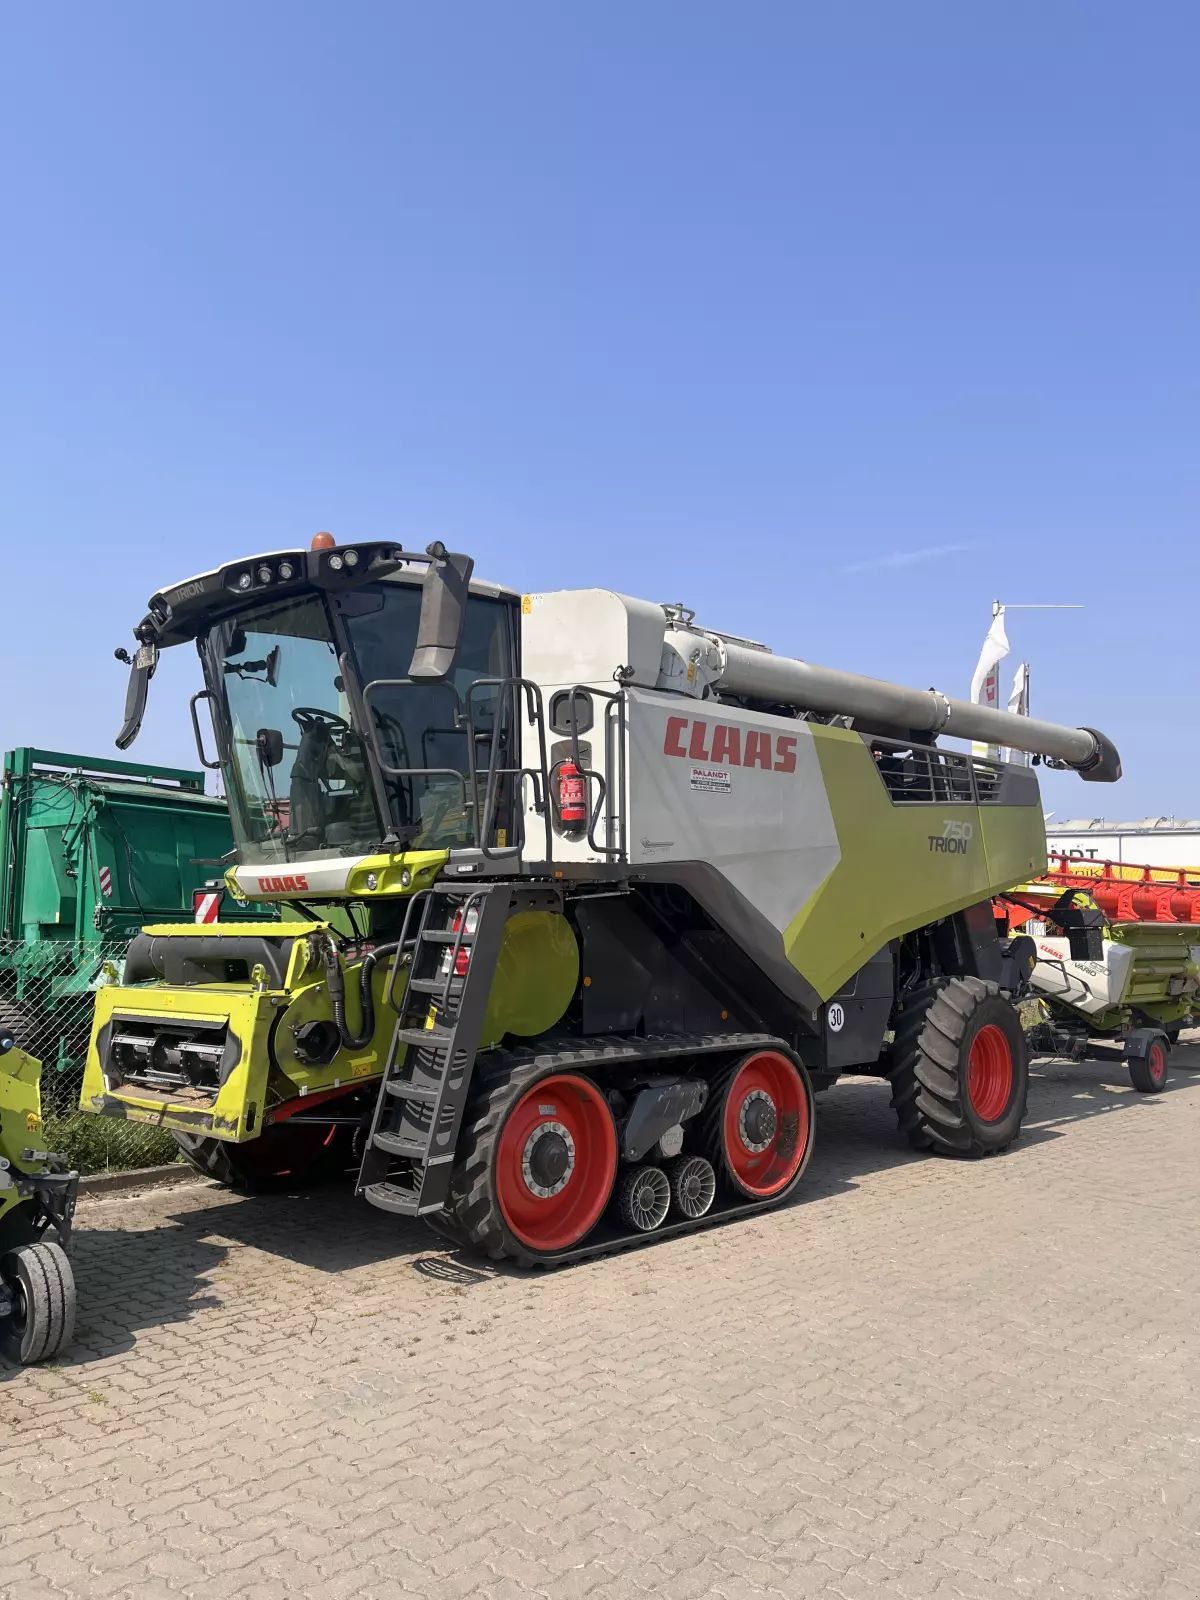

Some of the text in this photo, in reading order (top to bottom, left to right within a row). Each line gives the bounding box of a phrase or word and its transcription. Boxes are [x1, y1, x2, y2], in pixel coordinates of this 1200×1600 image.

[176, 580, 205, 601] TRION
[663, 716, 798, 773] CLAAS
[943, 820, 973, 840] 750
[928, 836, 967, 855] TRION
[257, 875, 309, 893] CLAAS
[1040, 944, 1064, 960] CLAAS
[1074, 962, 1097, 977] VARIO
[831, 1009, 842, 1026] 30
